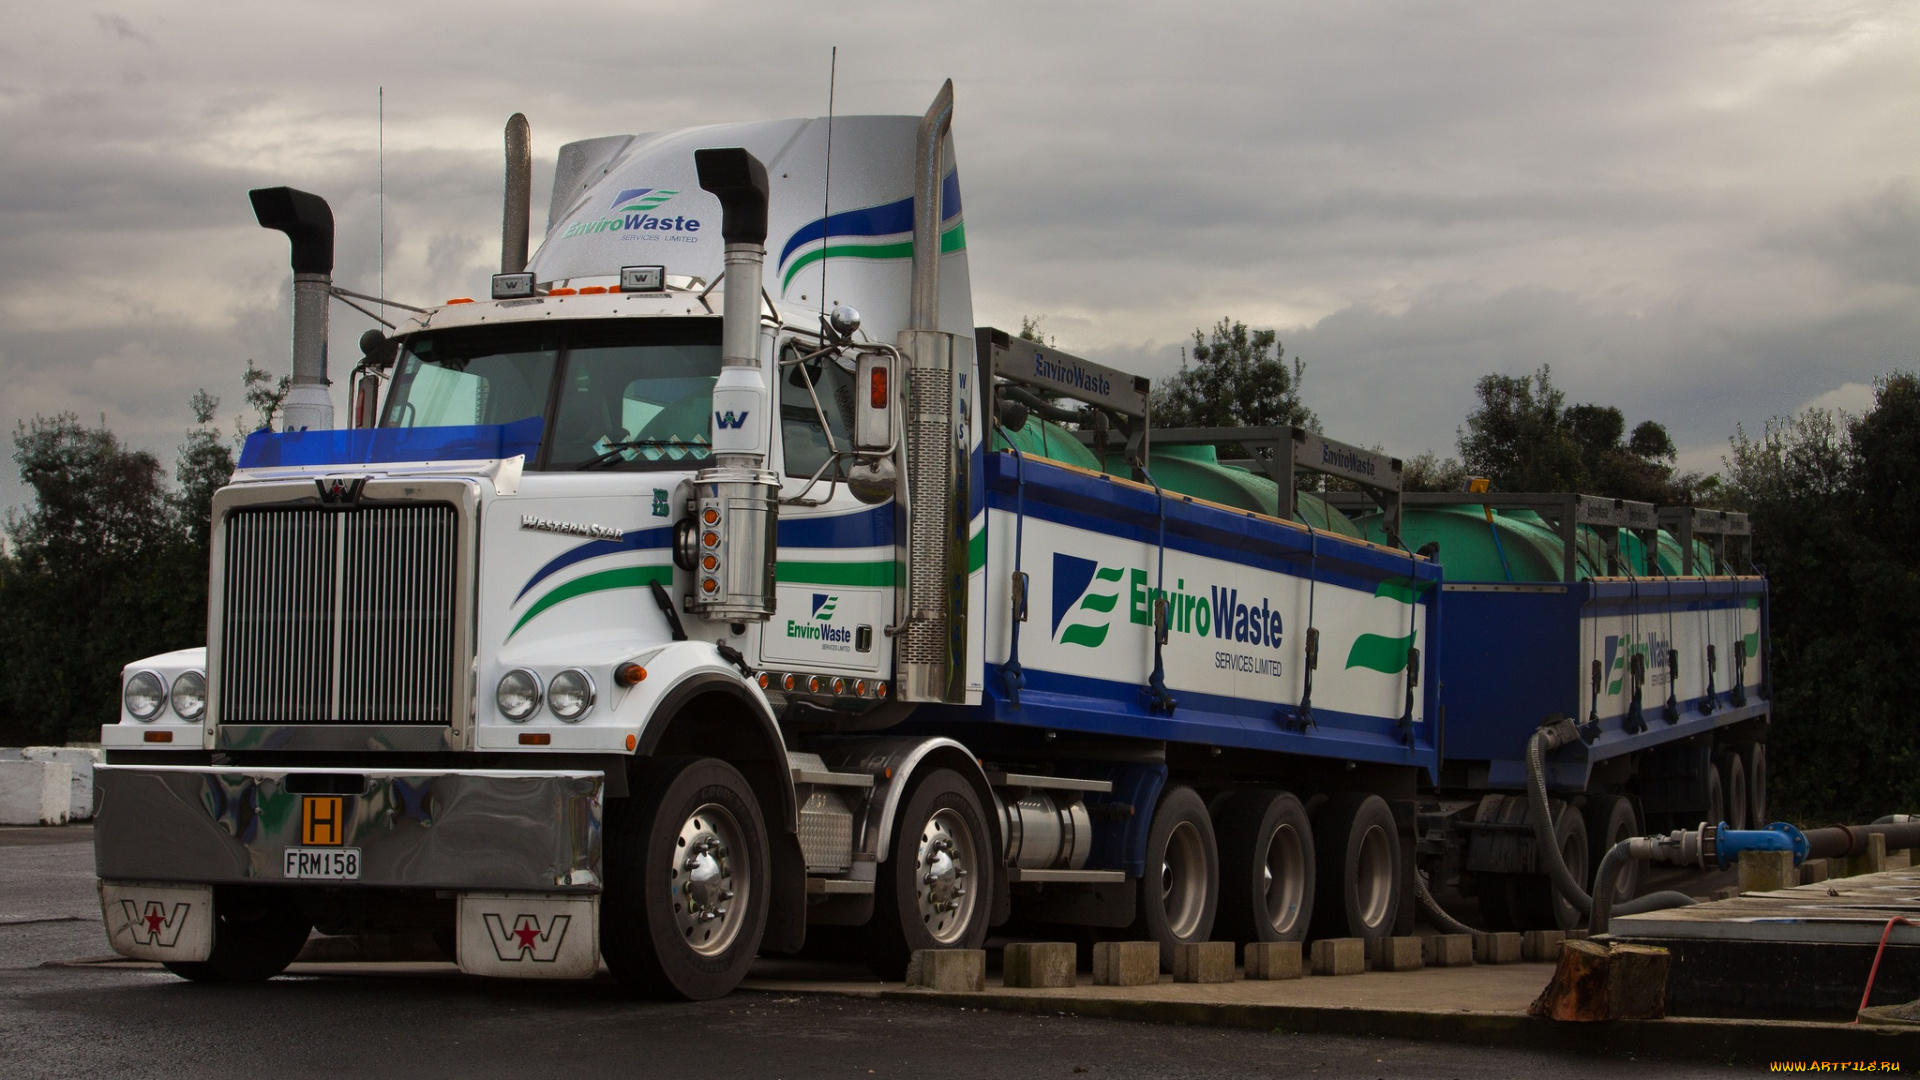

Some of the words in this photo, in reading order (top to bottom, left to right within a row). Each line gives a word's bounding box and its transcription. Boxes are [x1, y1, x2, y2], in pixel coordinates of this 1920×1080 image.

[562, 214, 700, 239] EnviroWaste
[621, 234, 660, 242] SERVICES
[664, 235, 698, 243] LIMITED
[1035, 353, 1110, 396] EnviroWaste
[1323, 444, 1375, 476] EnviroWaste
[787, 619, 851, 643] EnviroWaste
[1215, 651, 1254, 673] SERVICES
[1254, 657, 1282, 677] LIMITED
[309, 799, 336, 842] H
[286, 852, 357, 875] FRM158
